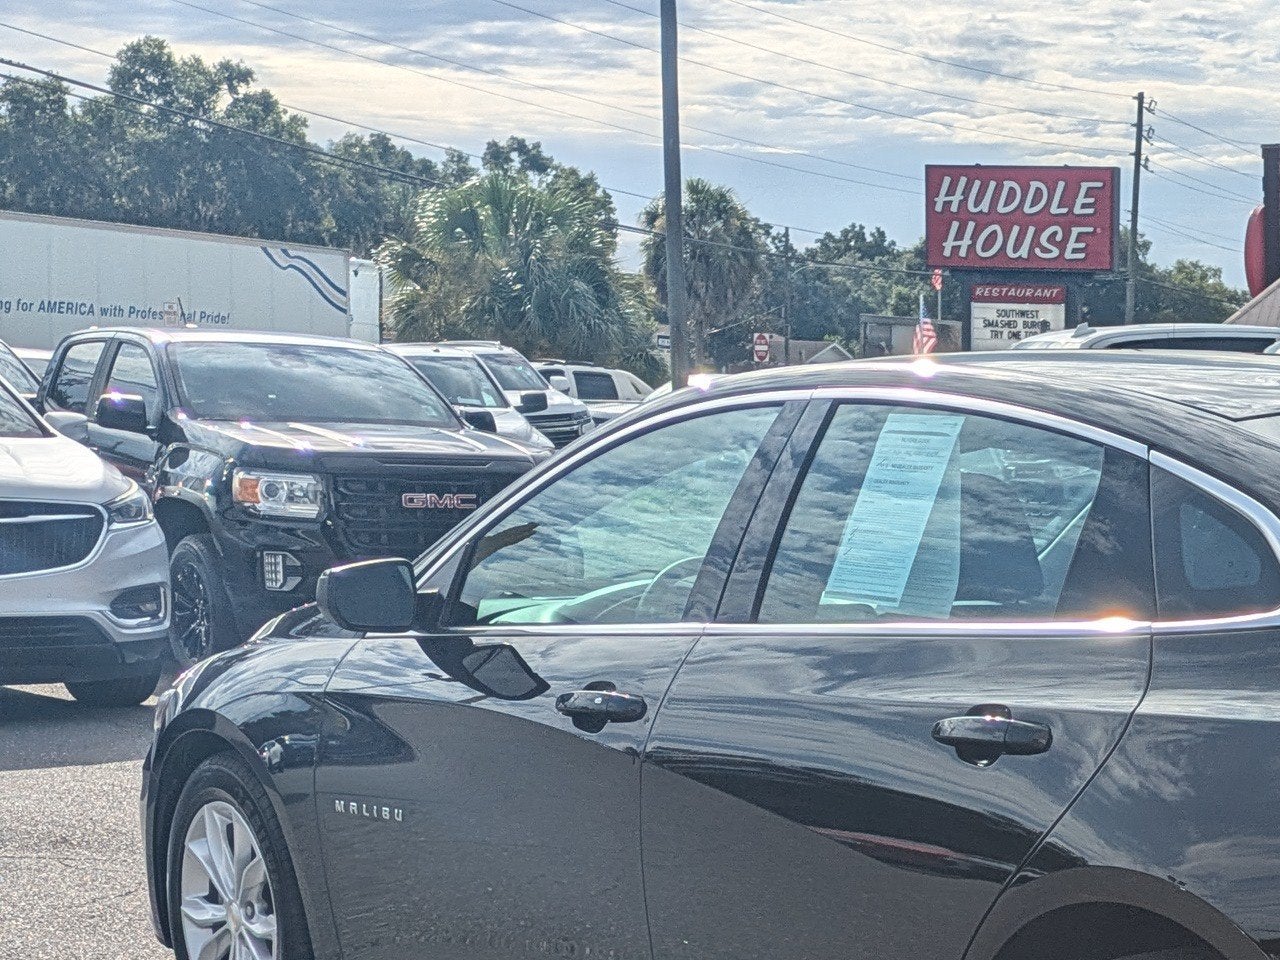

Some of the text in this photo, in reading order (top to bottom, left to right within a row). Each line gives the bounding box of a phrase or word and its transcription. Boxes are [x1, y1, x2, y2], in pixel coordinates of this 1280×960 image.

[934, 176, 1104, 214] HUDDLE
[942, 221, 1094, 260] HOUSE
[975, 287, 1060, 298] RESTAURANT
[16, 298, 35, 312] for
[37, 300, 95, 316] AMERICA
[100, 305, 124, 318] with
[128, 306, 196, 322] Profesnal
[199, 310, 231, 324] Pride!
[996, 309, 1040, 319] SOUTHWEST
[983, 319, 1018, 329] SMASHED
[990, 330, 1004, 339] TRY
[1007, 330, 1022, 340] ONE
[401, 493, 477, 509] GMC
[334, 799, 403, 821] MALIBU
